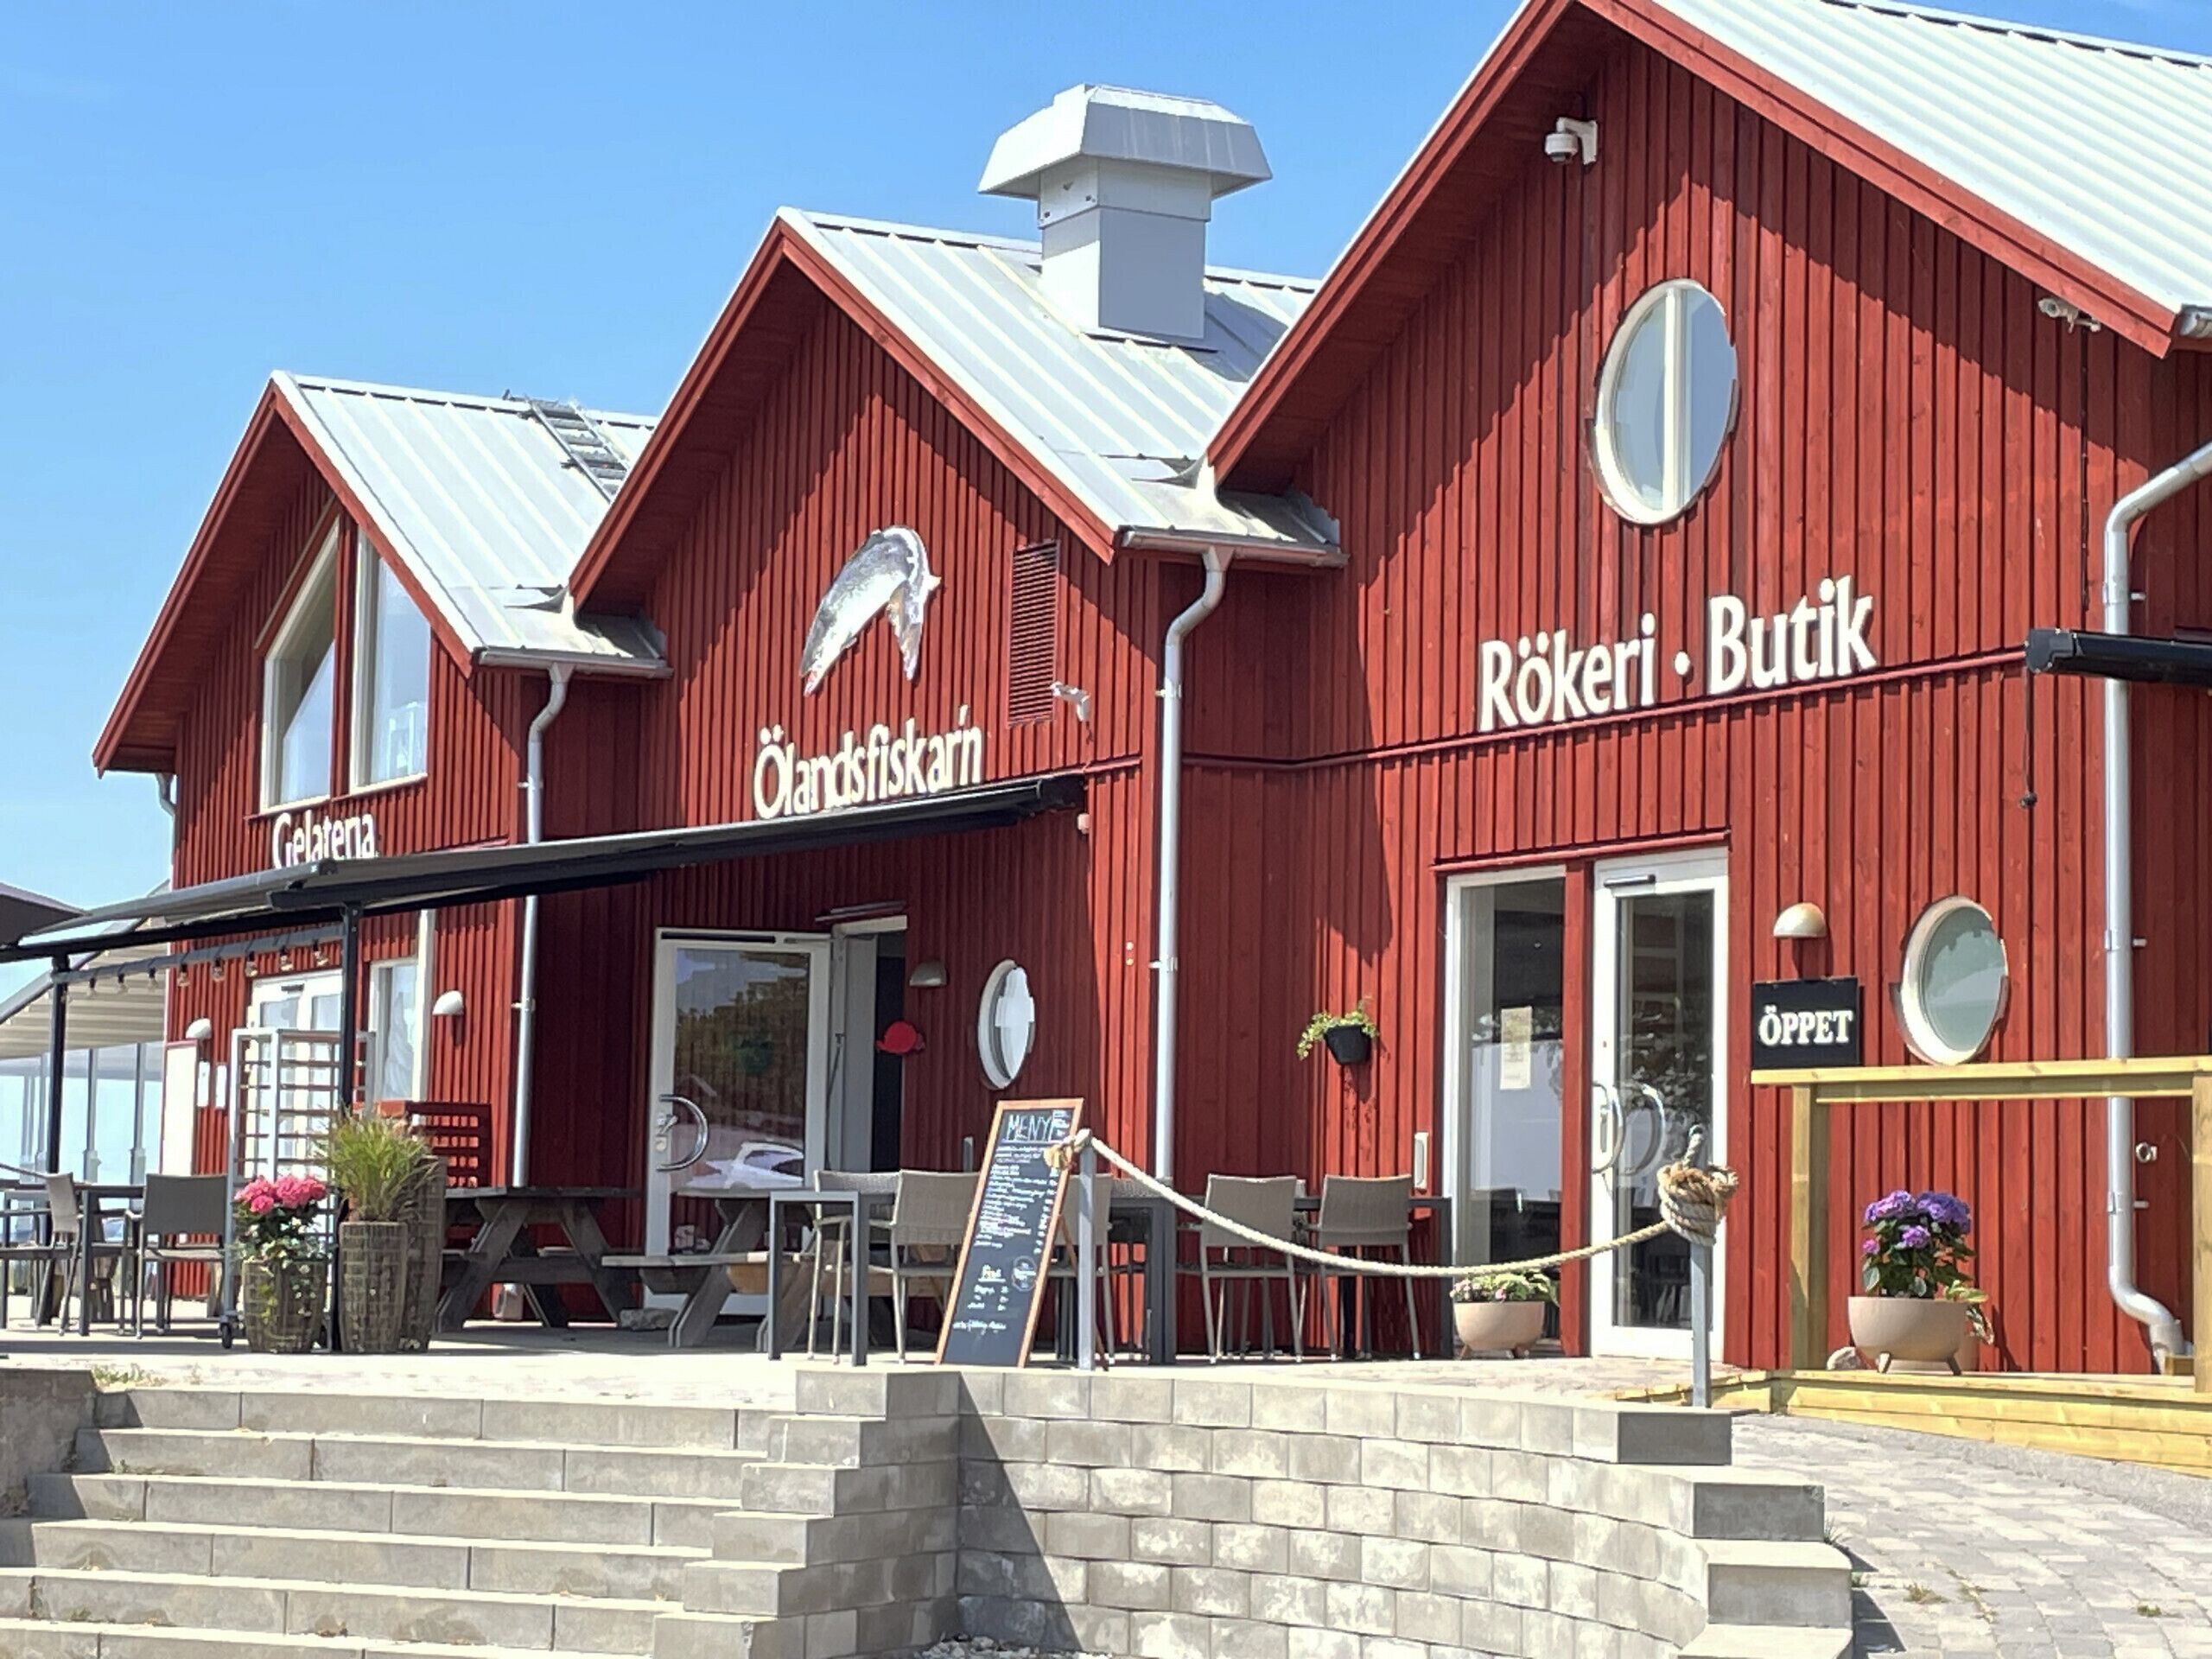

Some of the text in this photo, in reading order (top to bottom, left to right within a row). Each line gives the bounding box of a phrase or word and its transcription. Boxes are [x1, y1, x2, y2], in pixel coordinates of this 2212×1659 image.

[1478, 575, 1878, 732] Rökeri Butik
[1758, 1004, 1853, 1046] ÖPPET
